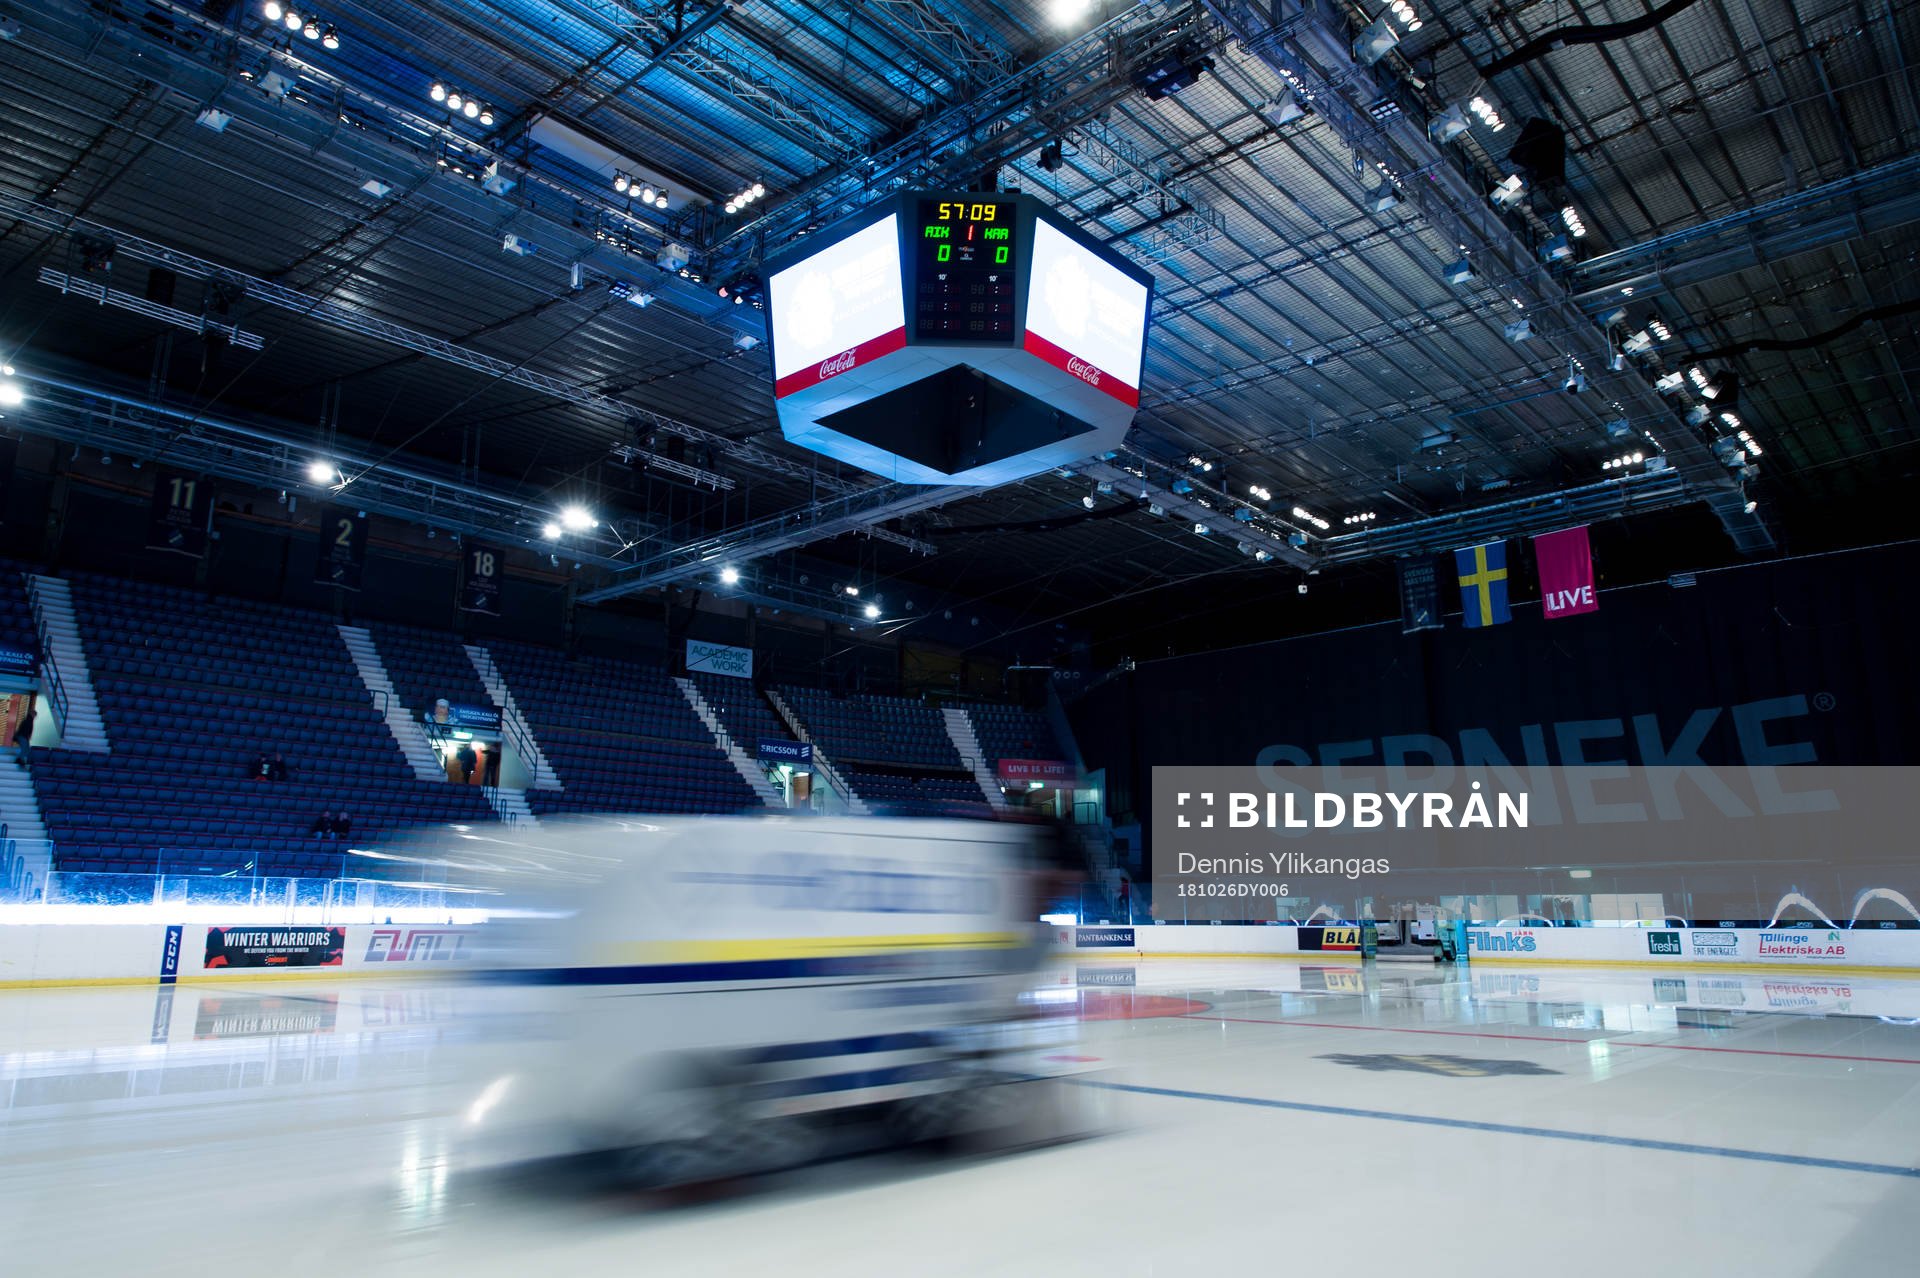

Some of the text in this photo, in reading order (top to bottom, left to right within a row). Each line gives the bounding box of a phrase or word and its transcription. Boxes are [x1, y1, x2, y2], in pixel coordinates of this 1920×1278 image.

[938, 203, 996, 221] 57:09
[925, 226, 950, 238] AIK
[967, 225, 974, 241] 1
[937, 244, 951, 262] 0
[995, 246, 1009, 263] 0
[169, 477, 197, 511] 11
[335, 518, 353, 547] 2
[472, 551, 495, 577] 18
[691, 645, 748, 662] ACADEMIC
[711, 659, 746, 673] WORK
[761, 744, 798, 755] ERICSSON
[1008, 765, 1028, 773] LIVE
[1031, 765, 1040, 773] IS
[224, 932, 331, 947] WINTER WARRIORS
[1078, 933, 1132, 942] PANTBANKEN.SE
[1325, 929, 1361, 944] BLÅ
[1466, 931, 1537, 951] Flinks
[166, 930, 178, 970] CCM
[1760, 943, 1845, 955] Elektriska AB
